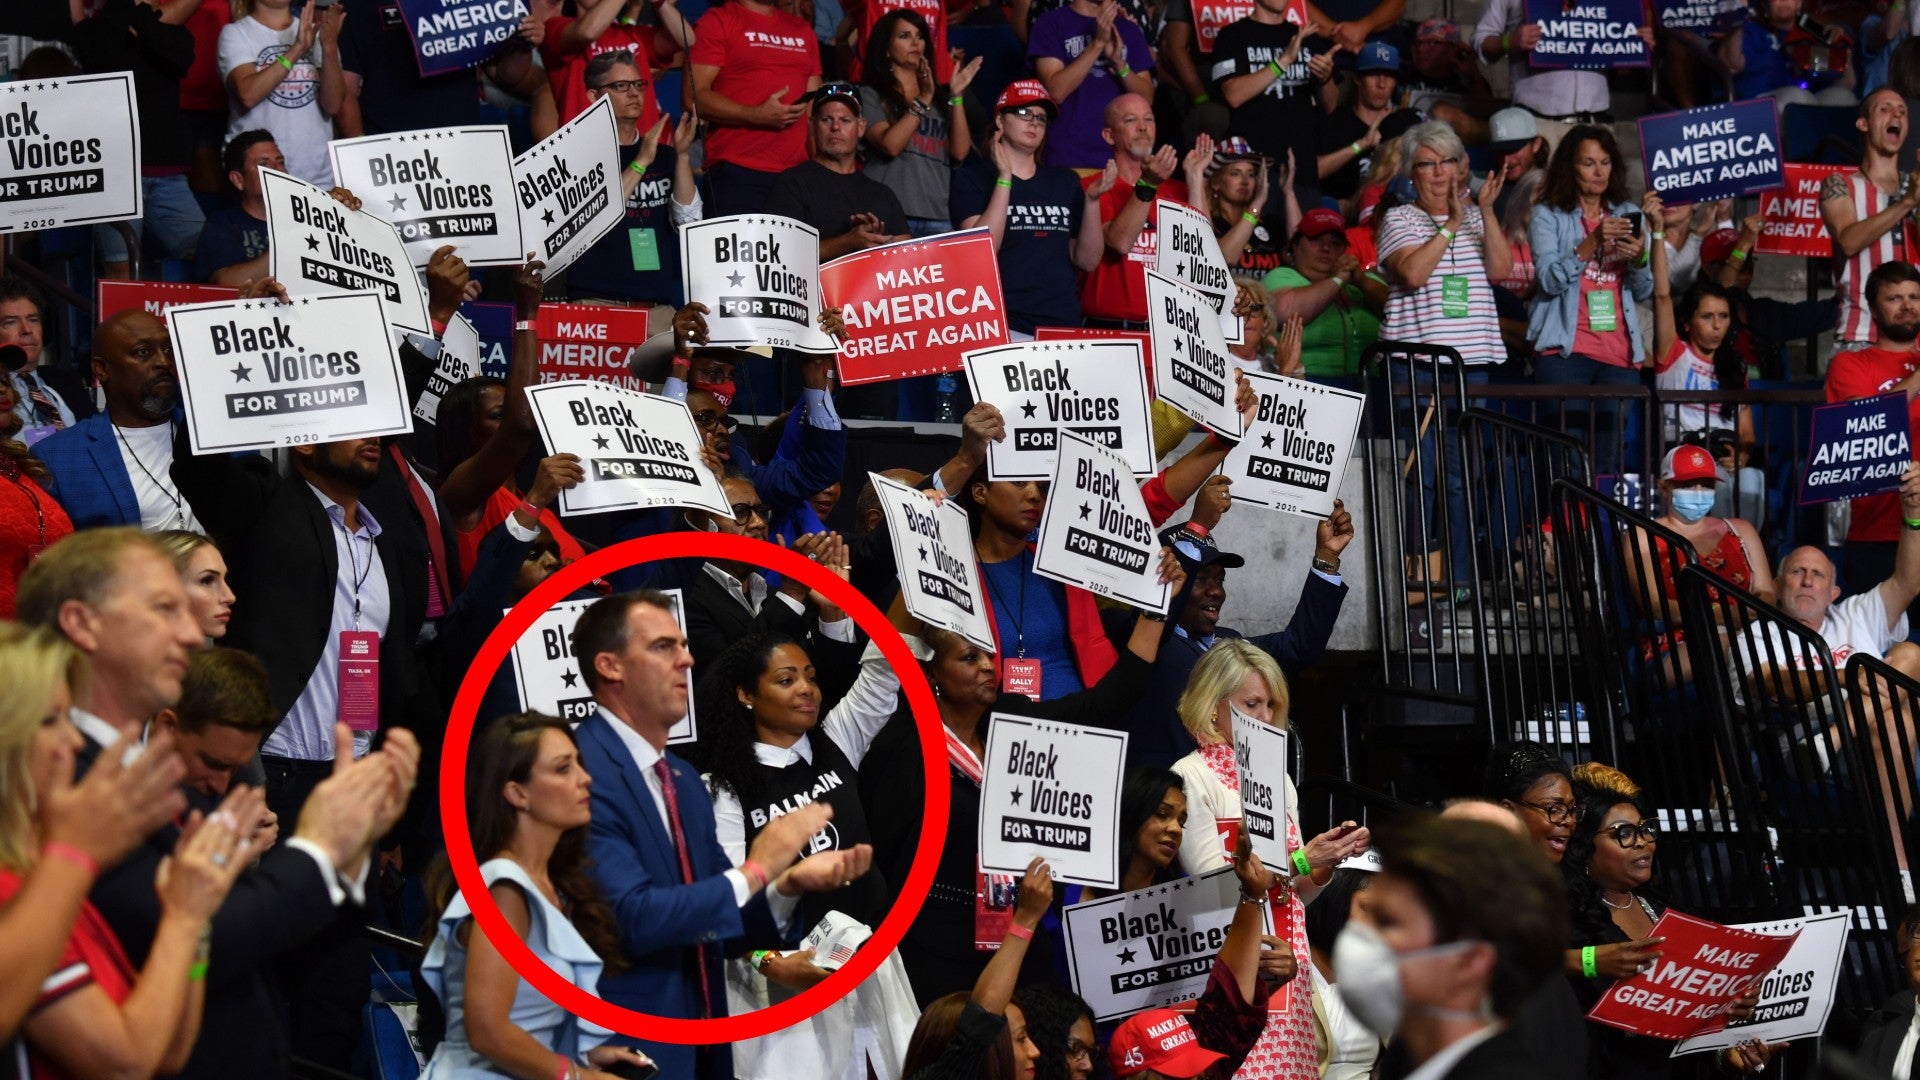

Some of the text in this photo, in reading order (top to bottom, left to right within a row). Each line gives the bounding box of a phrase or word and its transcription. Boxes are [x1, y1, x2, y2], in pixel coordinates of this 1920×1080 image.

[417, 0, 529, 38] AMERICA
[1537, 19, 1639, 40] AMERICA
[421, 23, 518, 58] GREAT AGA
[745, 32, 806, 48] TRUMP
[1247, 46, 1273, 63] BAN
[1535, 40, 1645, 55] GREAT AGAIN
[1682, 118, 1737, 141] MAKE
[8, 133, 103, 171] Voices
[368, 149, 443, 188] Black
[1651, 132, 1776, 172] AMERICA
[27, 174, 99, 196] TRUMP
[518, 154, 572, 210] Black
[555, 162, 606, 217] Voices
[1653, 157, 1778, 192] GREAT AGAIN
[416, 178, 494, 212] Voices
[1006, 205, 1071, 217] TRUMP
[23, 218, 56, 230] 2020
[290, 194, 350, 239] Black
[436, 220, 495, 238] TRUMP
[547, 193, 606, 255] FOR TRUMP
[1011, 216, 1070, 226] PENCE
[1762, 221, 1815, 238] GREAT
[326, 232, 396, 279] Voices
[571, 244, 588, 262] 2020
[715, 232, 781, 265] Black
[1172, 223, 1205, 259] Black
[305, 265, 338, 285] FOR
[755, 263, 809, 302] Voices
[877, 263, 945, 291] MAKE
[1189, 256, 1228, 291] Voices
[725, 301, 808, 322] FOR TRUMP
[841, 285, 996, 330] AMERICA
[1165, 296, 1200, 338] Black
[210, 317, 296, 356] Black
[556, 322, 609, 341] MAKE
[766, 337, 791, 347] 2020
[842, 319, 1001, 359] GREAT AGAIN
[262, 346, 362, 384] Voices
[1186, 333, 1226, 380] Voices
[1003, 359, 1072, 393] Black
[1173, 363, 1224, 402] FOR TRUMP
[232, 385, 361, 413] FOR TRUMP
[568, 396, 638, 429] Black
[1046, 390, 1121, 423] Voices
[1190, 407, 1206, 422] 2020
[1257, 393, 1307, 430] Black
[285, 433, 320, 445] 2020
[1018, 431, 1055, 447] FOR
[1845, 412, 1888, 436] MAKE
[615, 427, 691, 462] Voices
[1282, 428, 1336, 466] Voices
[1811, 430, 1910, 466] AMERICA
[598, 461, 697, 482] FOR TRUMP
[1075, 457, 1121, 503] Black
[1252, 462, 1328, 488] FOR TRUMP
[1807, 459, 1912, 487] GREAT AGAIN
[647, 496, 676, 506] 2020
[1274, 502, 1298, 513] 2020
[902, 502, 942, 543] Black
[1098, 498, 1152, 547] Voices
[930, 540, 969, 587] Voices
[1068, 532, 1146, 569] FOR TRUMP
[920, 576, 943, 593] FOR
[1089, 580, 1109, 594] 2020
[1007, 739, 1059, 780] Black
[750, 770, 843, 830] BALMAIN
[1030, 779, 1093, 820] Voices
[1003, 822, 1088, 847] FOR TRUMP
[1100, 902, 1178, 945] Black
[1693, 943, 1761, 970] MAKE
[1117, 975, 1160, 991] FOR
[1164, 991, 1197, 1005] 2020
[1614, 984, 1692, 1018] GREAT
[1754, 1000, 1806, 1022] TRUMP
[1147, 1022, 1177, 1040] MAKE
[1160, 1031, 1188, 1052] GREAT
[1123, 1045, 1145, 1068] 45
